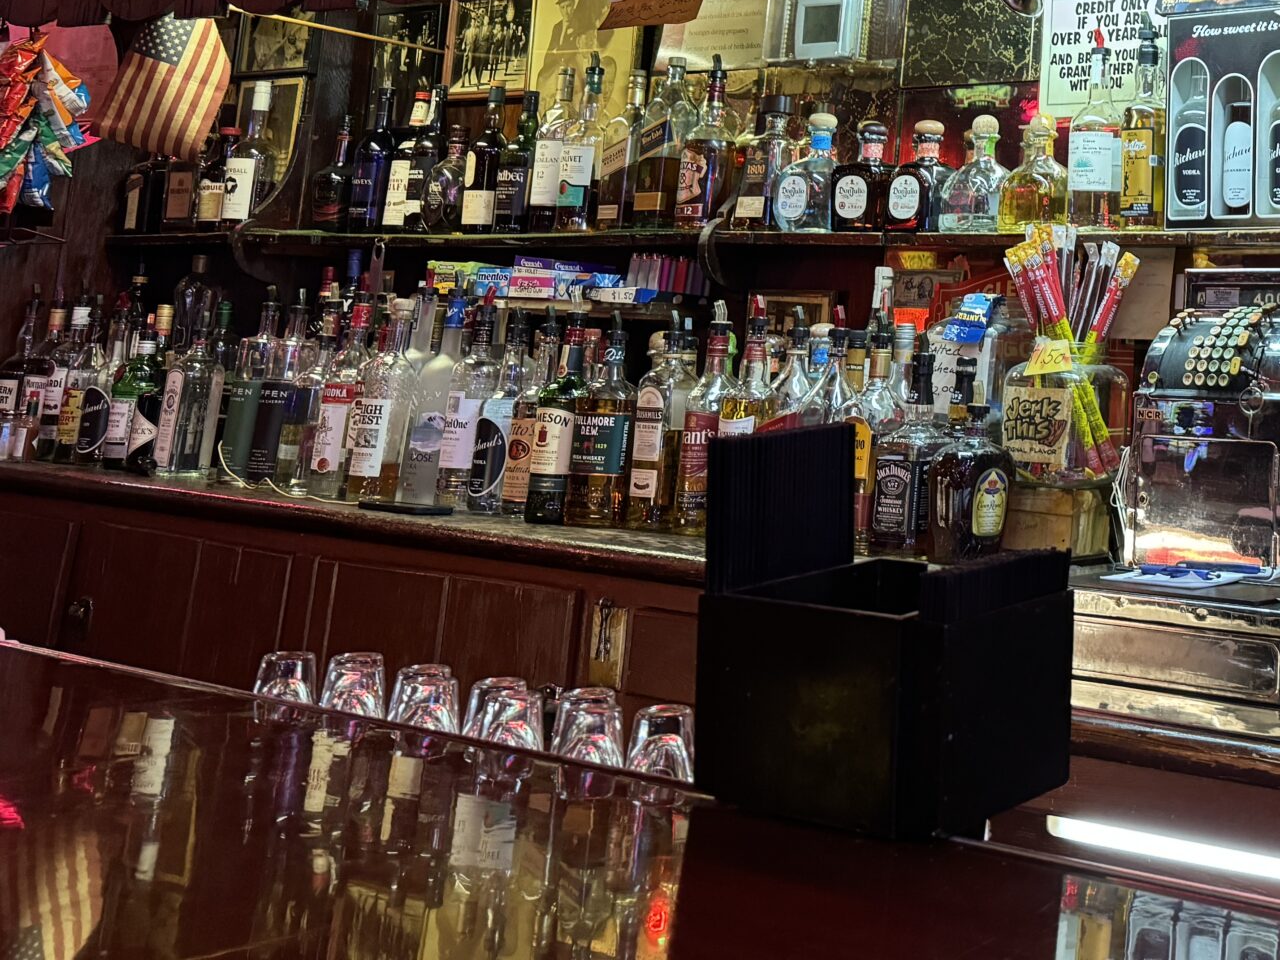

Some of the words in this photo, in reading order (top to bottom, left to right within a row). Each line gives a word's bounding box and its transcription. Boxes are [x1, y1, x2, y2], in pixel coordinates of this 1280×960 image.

[1076, 0, 1115, 15] CREDIT
[1077, 17, 1087, 29] IF
[1096, 13, 1119, 28] YOU
[1192, 24, 1221, 38] How
[1223, 22, 1255, 34] sweet
[1256, 21, 1267, 32] it
[1268, 20, 1278, 31] is
[1052, 32, 1081, 46] OVER
[1050, 53, 1072, 65] AND
[478, 272, 510, 282] mentos
[611, 291, 634, 301] $1.50
[1006, 396, 1062, 419] Jerk
[1137, 410, 1161, 419] NCR
[877, 466, 890, 480] JACK
[878, 506, 903, 514] WHISKEY
